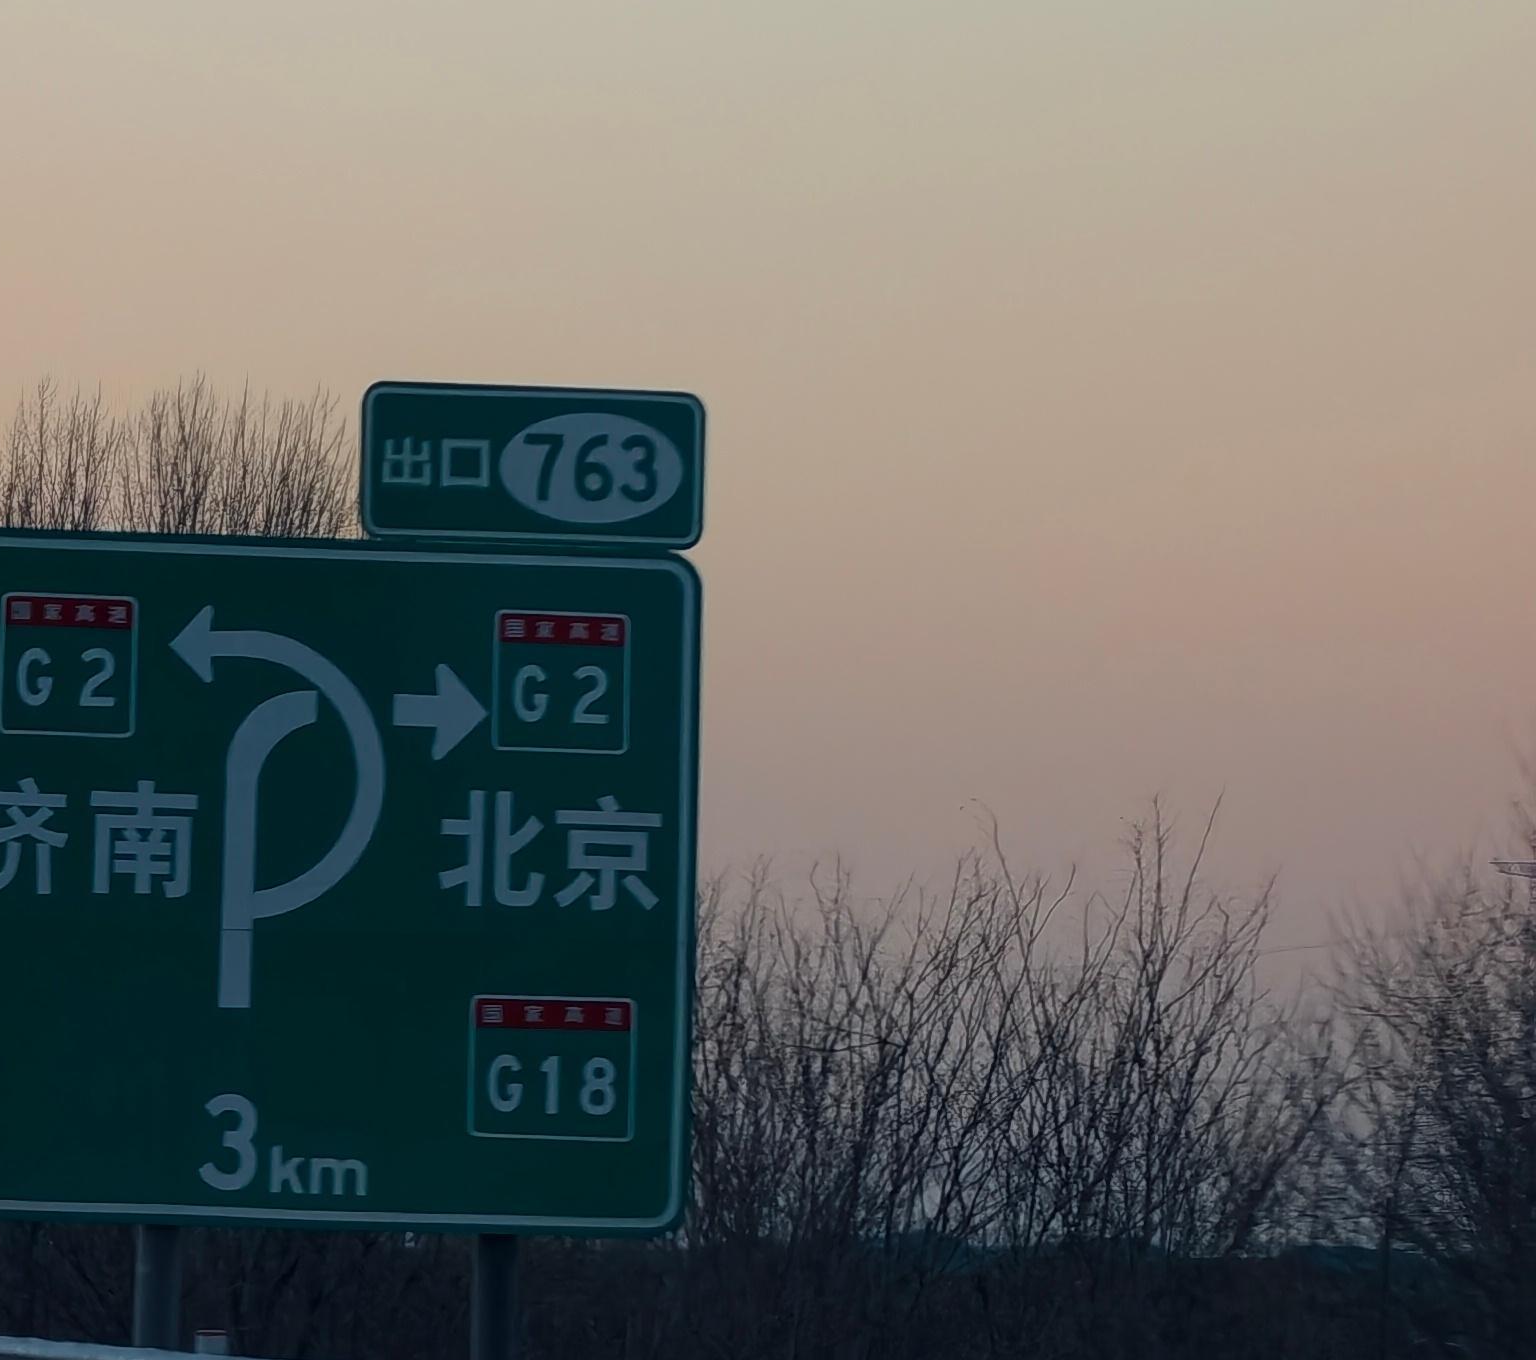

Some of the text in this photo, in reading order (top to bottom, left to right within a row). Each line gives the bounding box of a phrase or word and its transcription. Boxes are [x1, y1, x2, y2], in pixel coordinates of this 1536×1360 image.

[383, 432, 659, 503] 出口 763
[438, 789, 663, 911] 北京
[489, 1054, 616, 1116] G18
